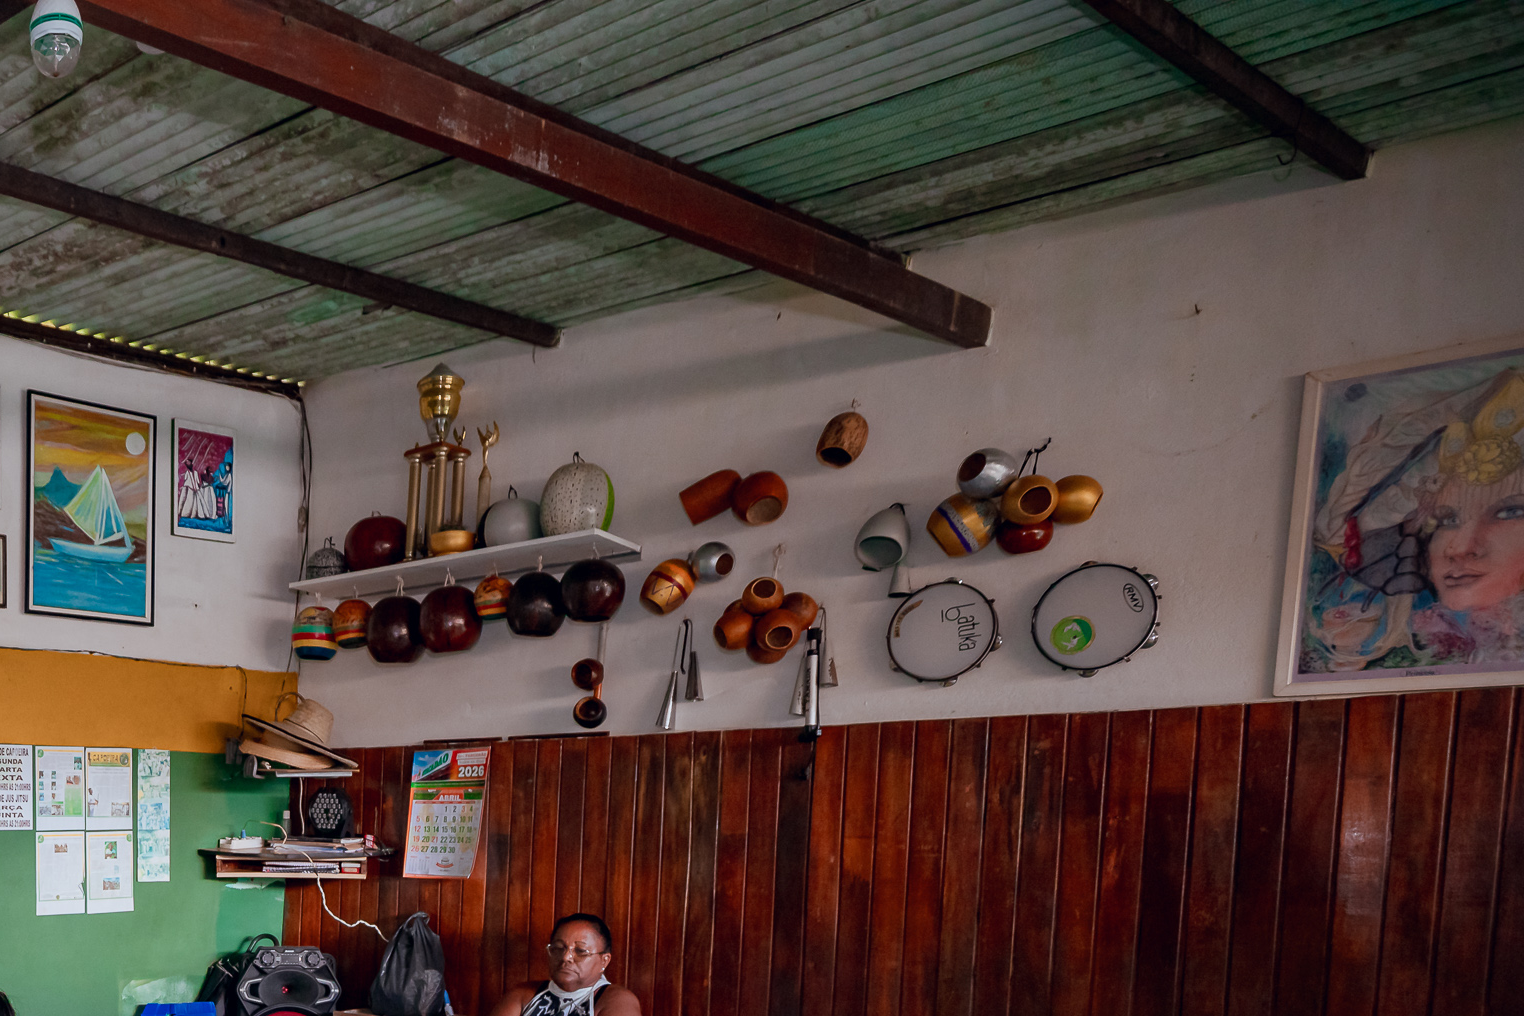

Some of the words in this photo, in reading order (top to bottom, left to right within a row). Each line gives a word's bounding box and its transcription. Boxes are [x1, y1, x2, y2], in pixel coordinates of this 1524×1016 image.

[1124, 586, 1143, 608] RMV
[944, 603, 982, 652] batuka
[0, 747, 5, 756] DE
[458, 765, 485, 778] 2026
[416, 815, 420, 823] 5
[426, 815, 430, 823] 6
[414, 825, 421, 833] 12
[410, 845, 419, 853] 26
[439, 846, 447, 854] 29
[448, 846, 456, 854] 30
